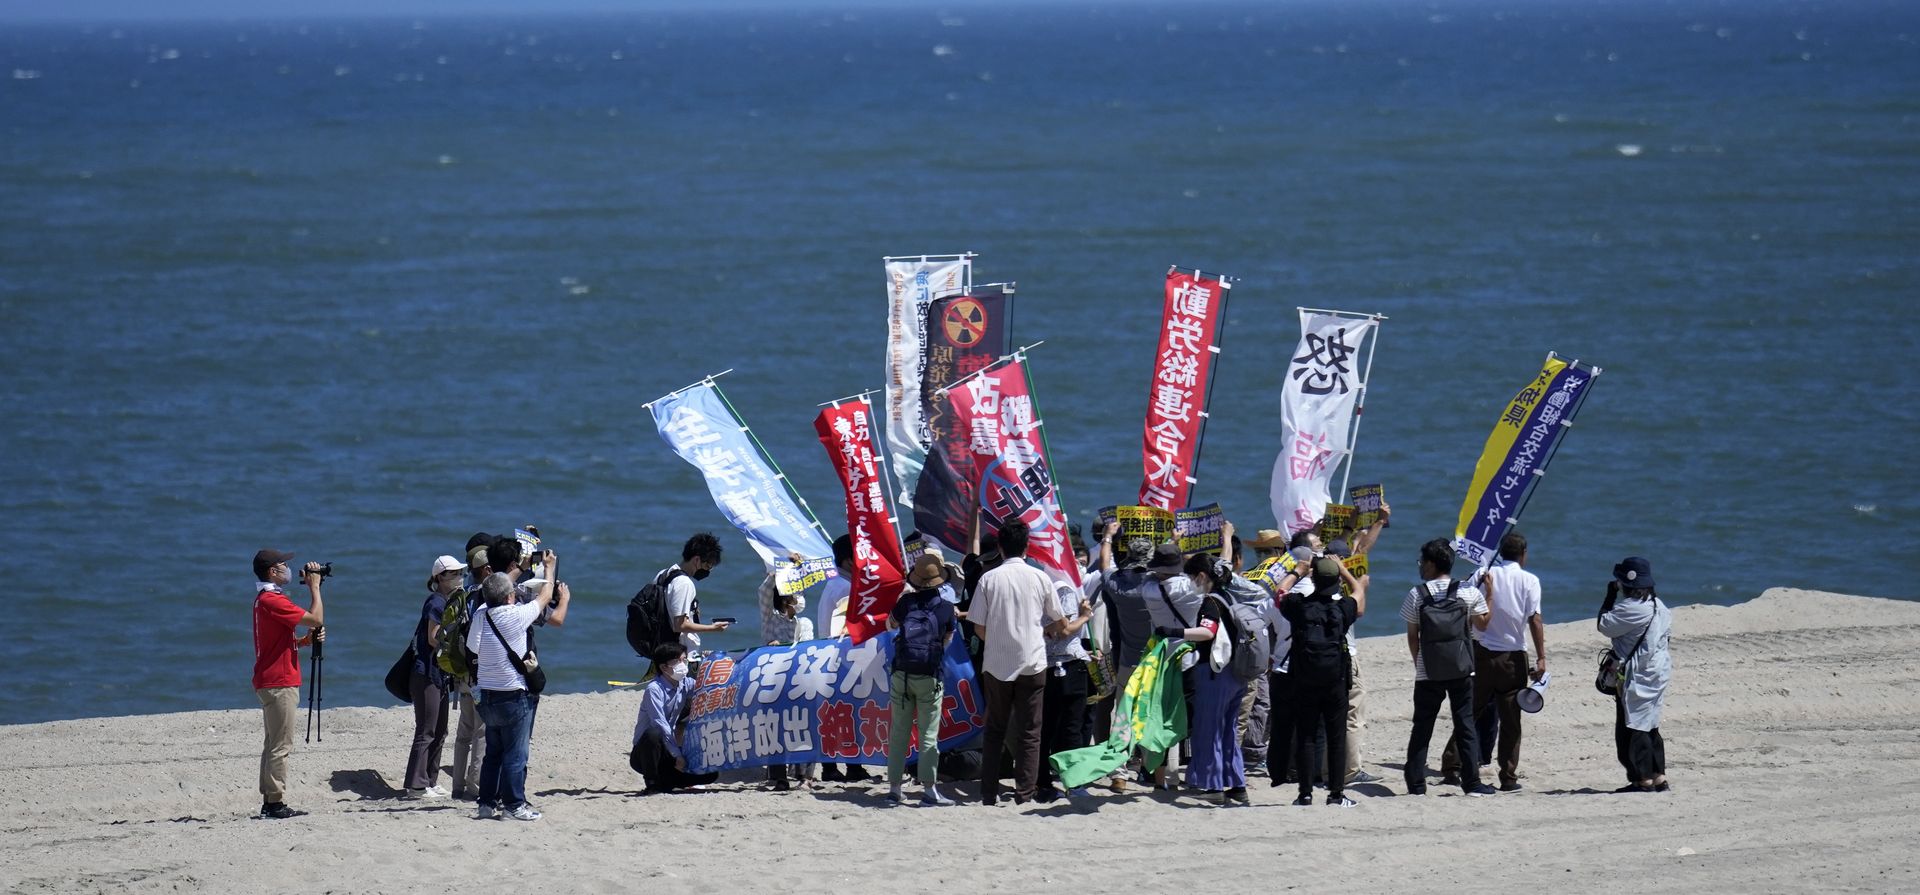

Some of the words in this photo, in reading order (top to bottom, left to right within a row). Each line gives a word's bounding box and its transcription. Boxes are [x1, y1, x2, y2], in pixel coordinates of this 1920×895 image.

[853, 410, 870, 442] 自力
[742, 637, 889, 707] 汚染水
[701, 705, 813, 769] 海洋放出
